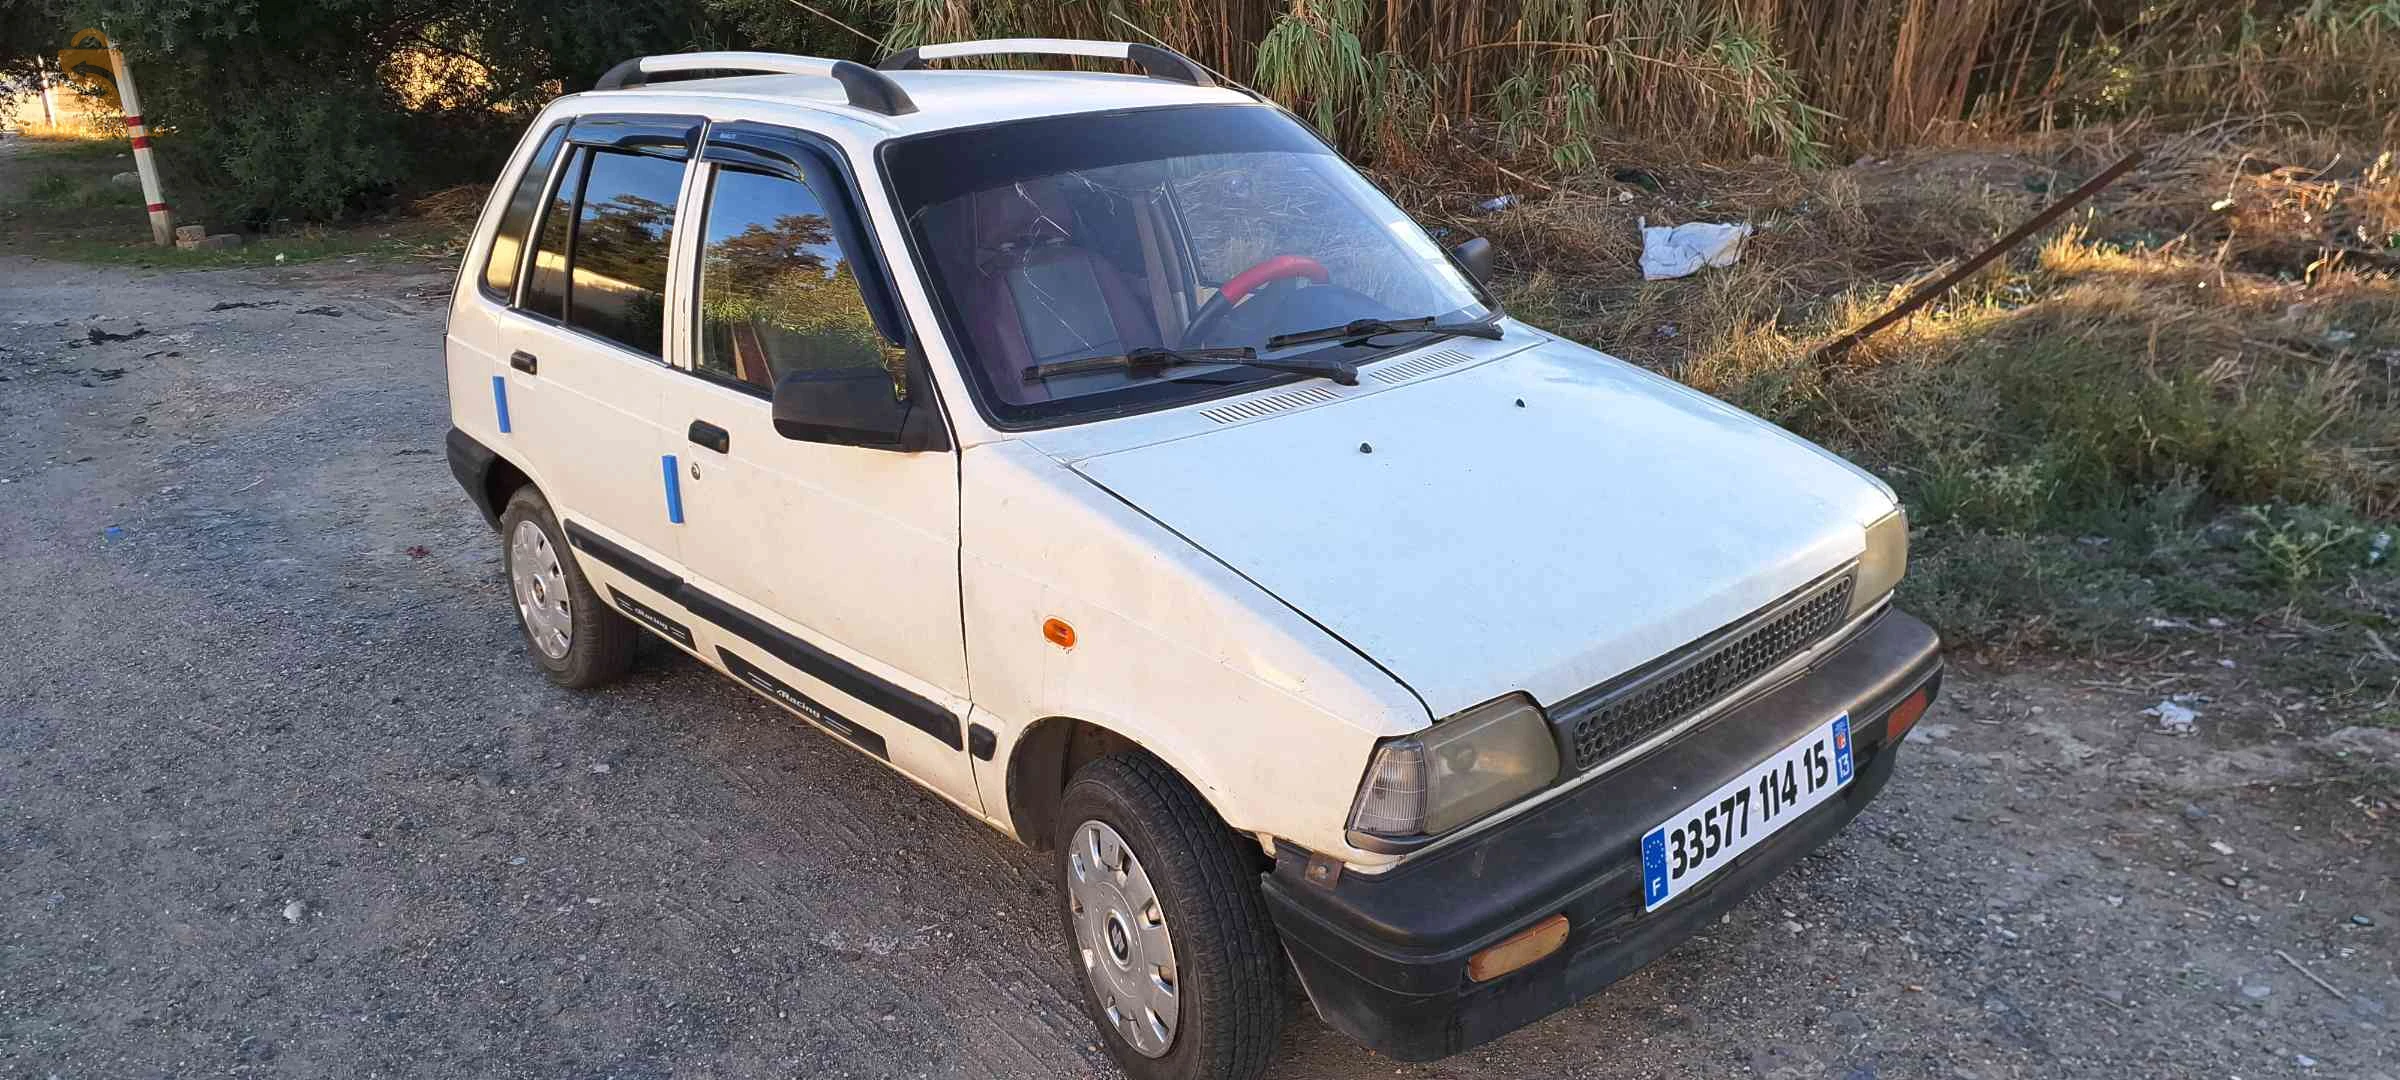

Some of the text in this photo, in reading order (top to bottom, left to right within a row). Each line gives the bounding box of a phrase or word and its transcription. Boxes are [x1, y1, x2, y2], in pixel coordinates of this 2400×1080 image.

[777, 689, 820, 719] Racing
[1838, 753, 1850, 778] 13
[1670, 739, 1829, 880] 33577 114 15
[1652, 877, 1662, 897] F
